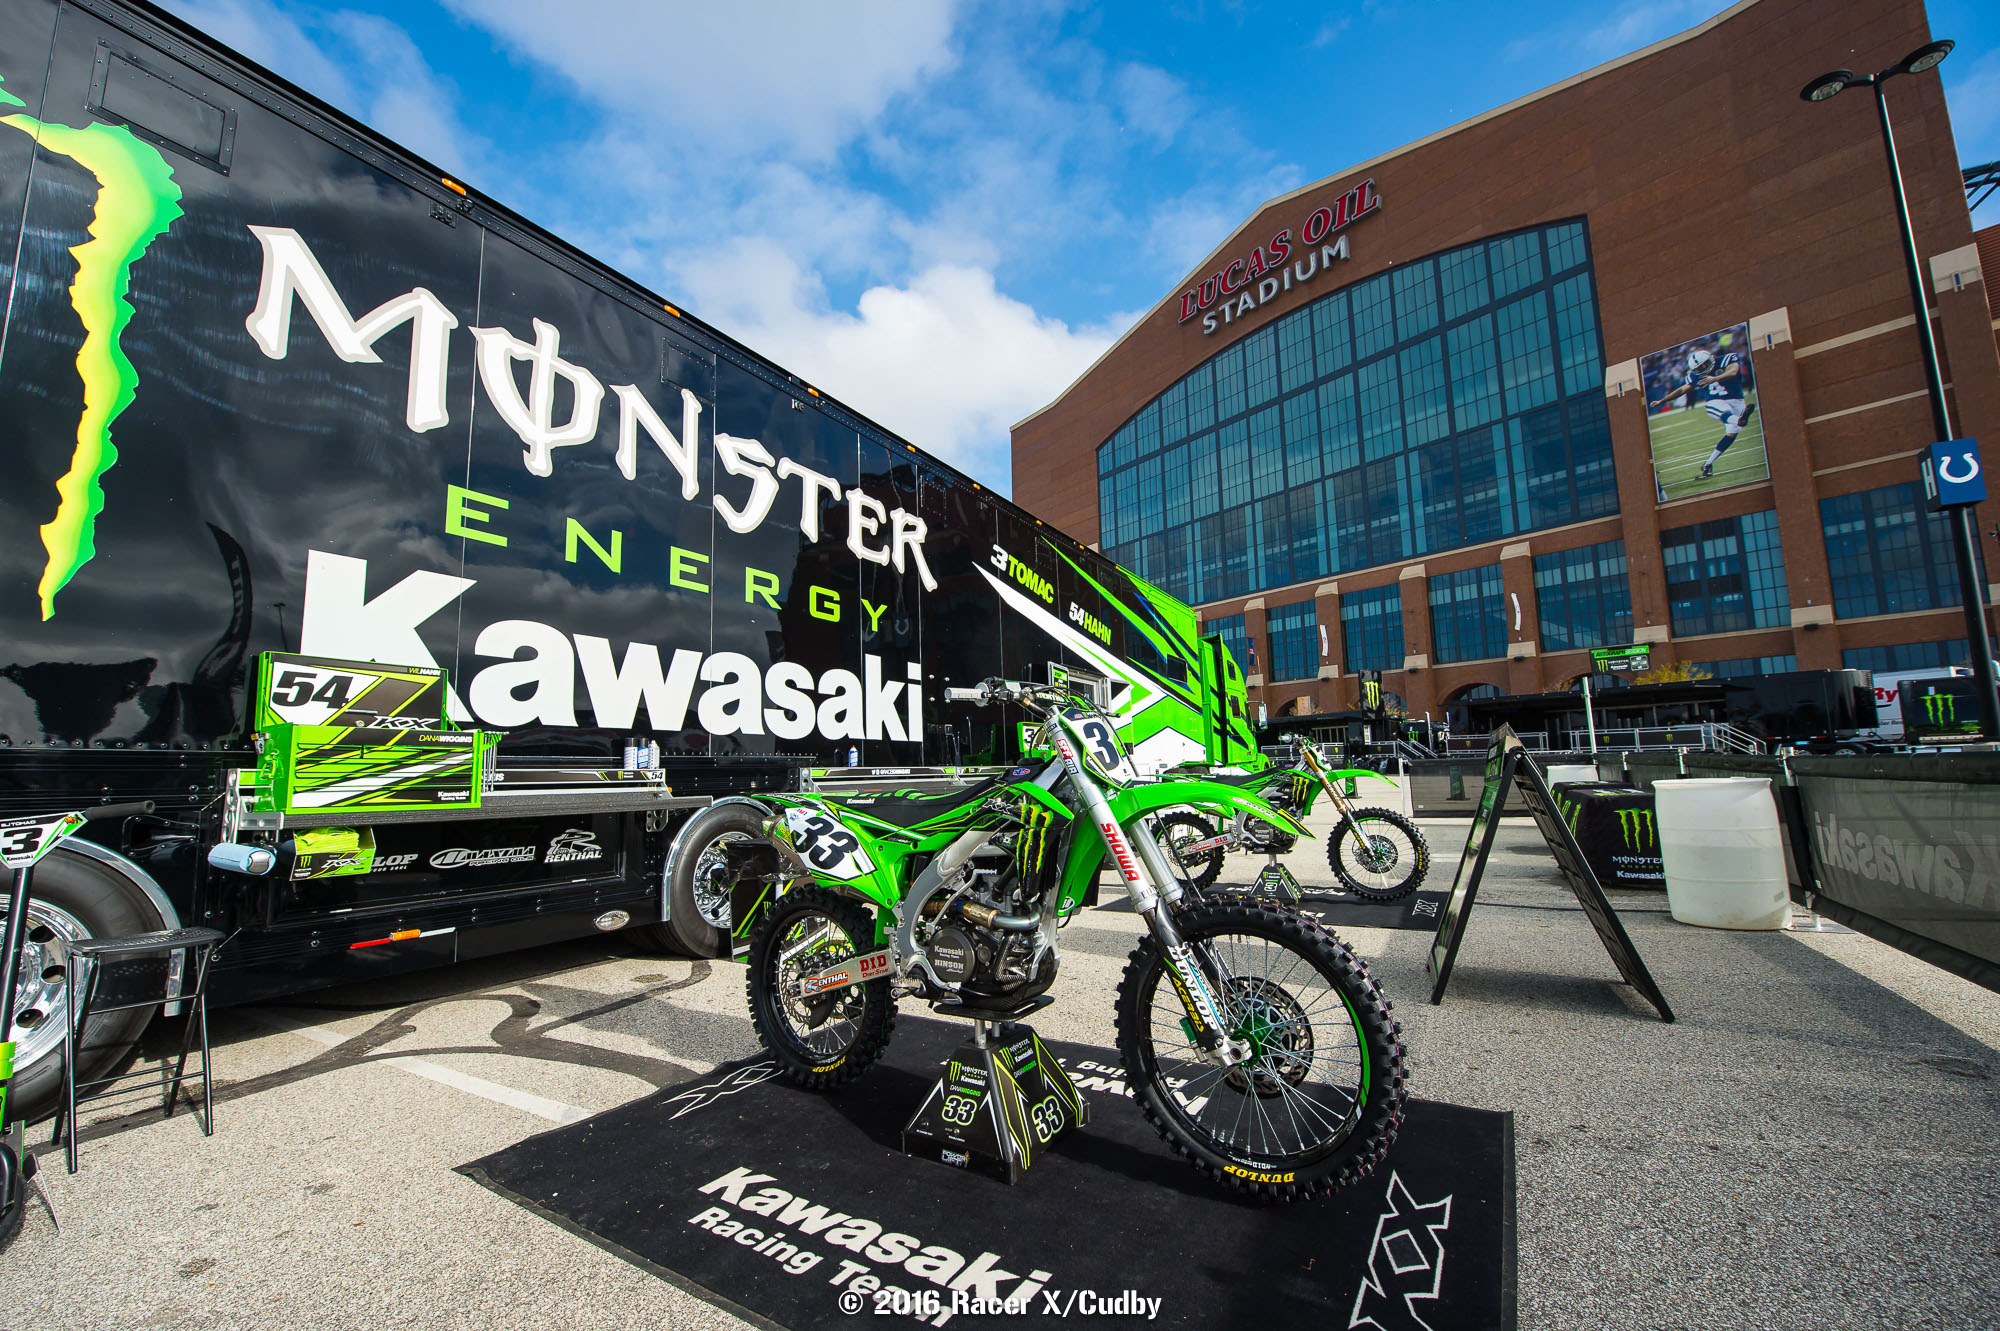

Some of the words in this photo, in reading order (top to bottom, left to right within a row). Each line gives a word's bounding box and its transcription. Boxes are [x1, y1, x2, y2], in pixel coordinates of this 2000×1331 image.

[1178, 229, 1292, 323] LUCAS
[1302, 177, 1382, 245] OIL
[1202, 234, 1351, 335] STADIUM
[246, 225, 938, 591] MONSTER
[445, 484, 888, 632] ENERGY
[301, 549, 923, 743] Kawasaki
[271, 670, 354, 709] 54
[2, 827, 43, 855] 3
[372, 853, 418, 868] LOP
[544, 851, 603, 864] RENTHAL
[791, 816, 860, 870] 33
[1100, 823, 1141, 881] SHOWA
[1616, 870, 1665, 880] Kawasaki
[859, 954, 887, 973] D.I.D
[961, 1075, 986, 1087] Kawasaki
[941, 1095, 977, 1126] 33
[1031, 1095, 1065, 1143] 33
[1223, 1164, 1295, 1184] DUNLOP
[697, 1166, 1054, 1304] Kawasaki
[687, 1207, 823, 1276] Racing
[828, 1260, 953, 1328] Team
